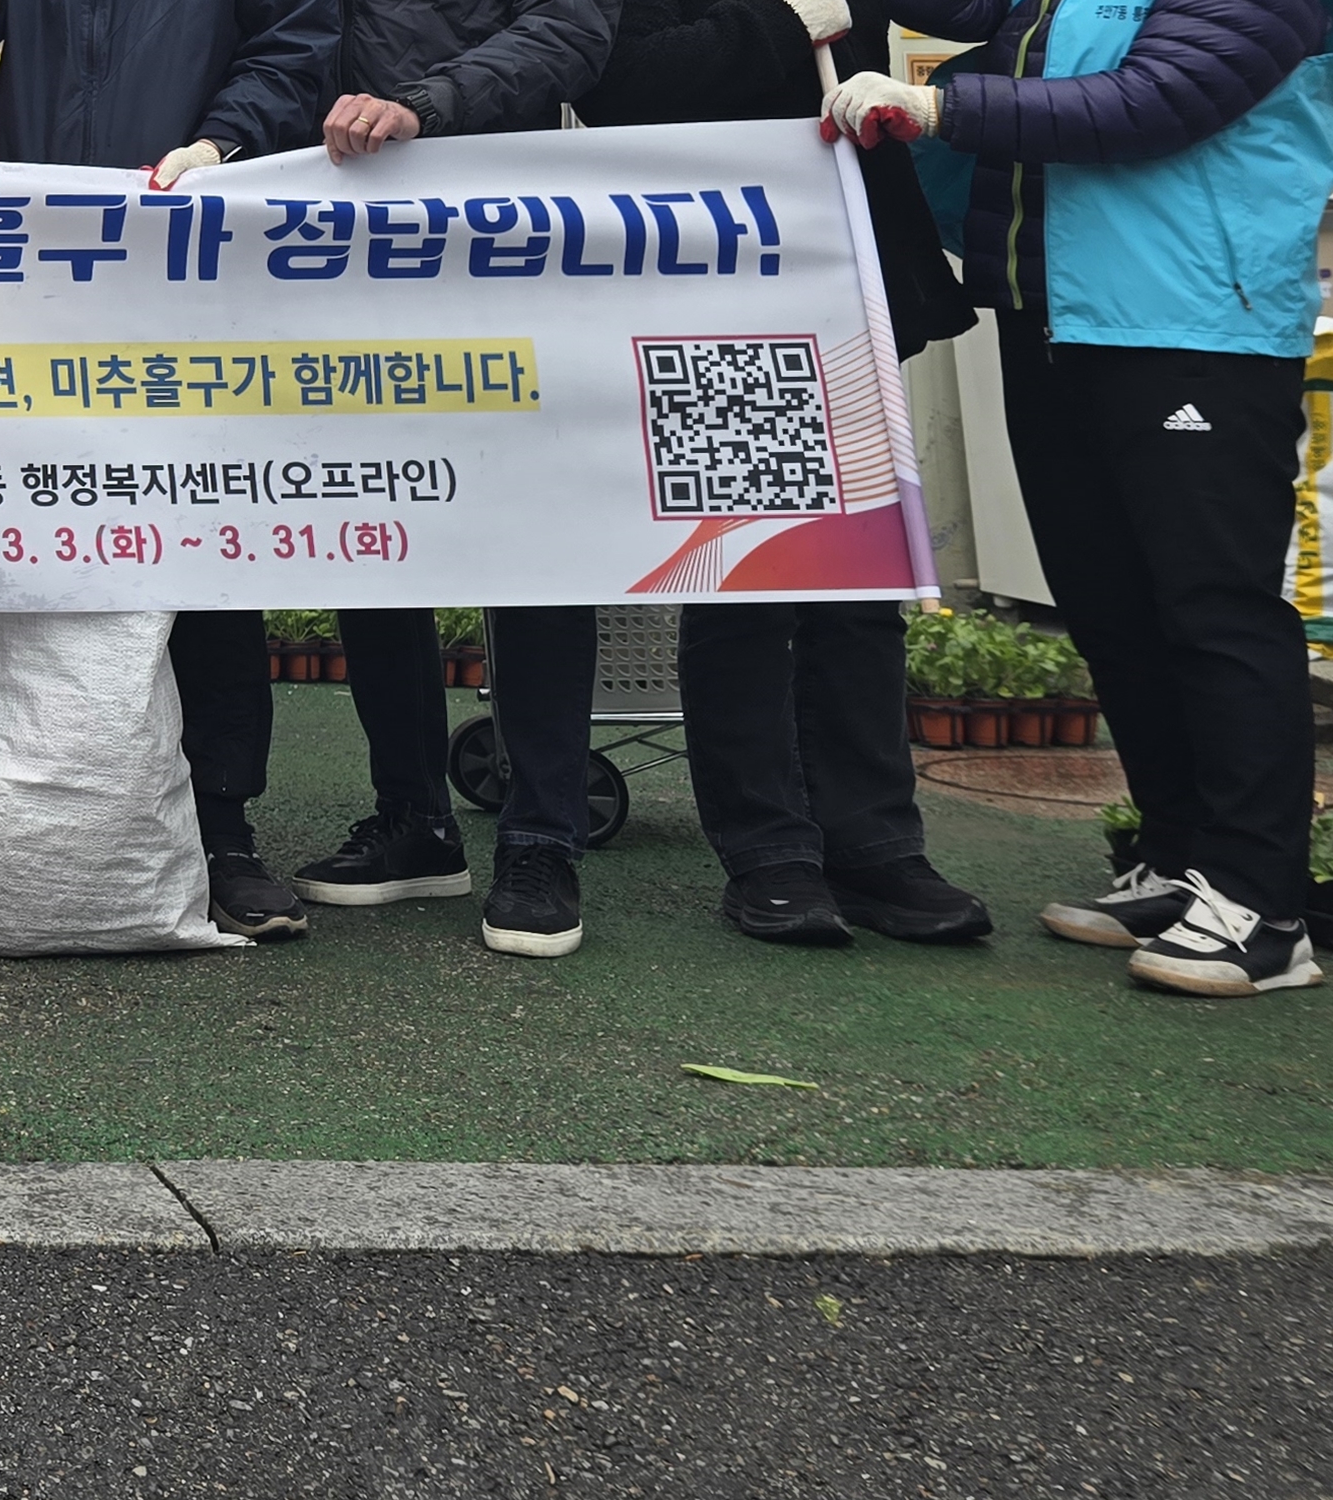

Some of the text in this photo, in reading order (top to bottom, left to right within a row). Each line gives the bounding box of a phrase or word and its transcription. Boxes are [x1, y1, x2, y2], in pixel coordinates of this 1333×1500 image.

[263, 184, 781, 281] 정답입니다!
[49, 353, 276, 409] 미추홀구가
[290, 350, 541, 406] 함께합니다.
[1163, 420, 1212, 432] adidas
[20, 457, 458, 507] 행정복지센터(오프라인)
[2, 527, 39, 564] 3.
[220, 525, 256, 561] 3.
[273, 520, 410, 562] 31.(화)
